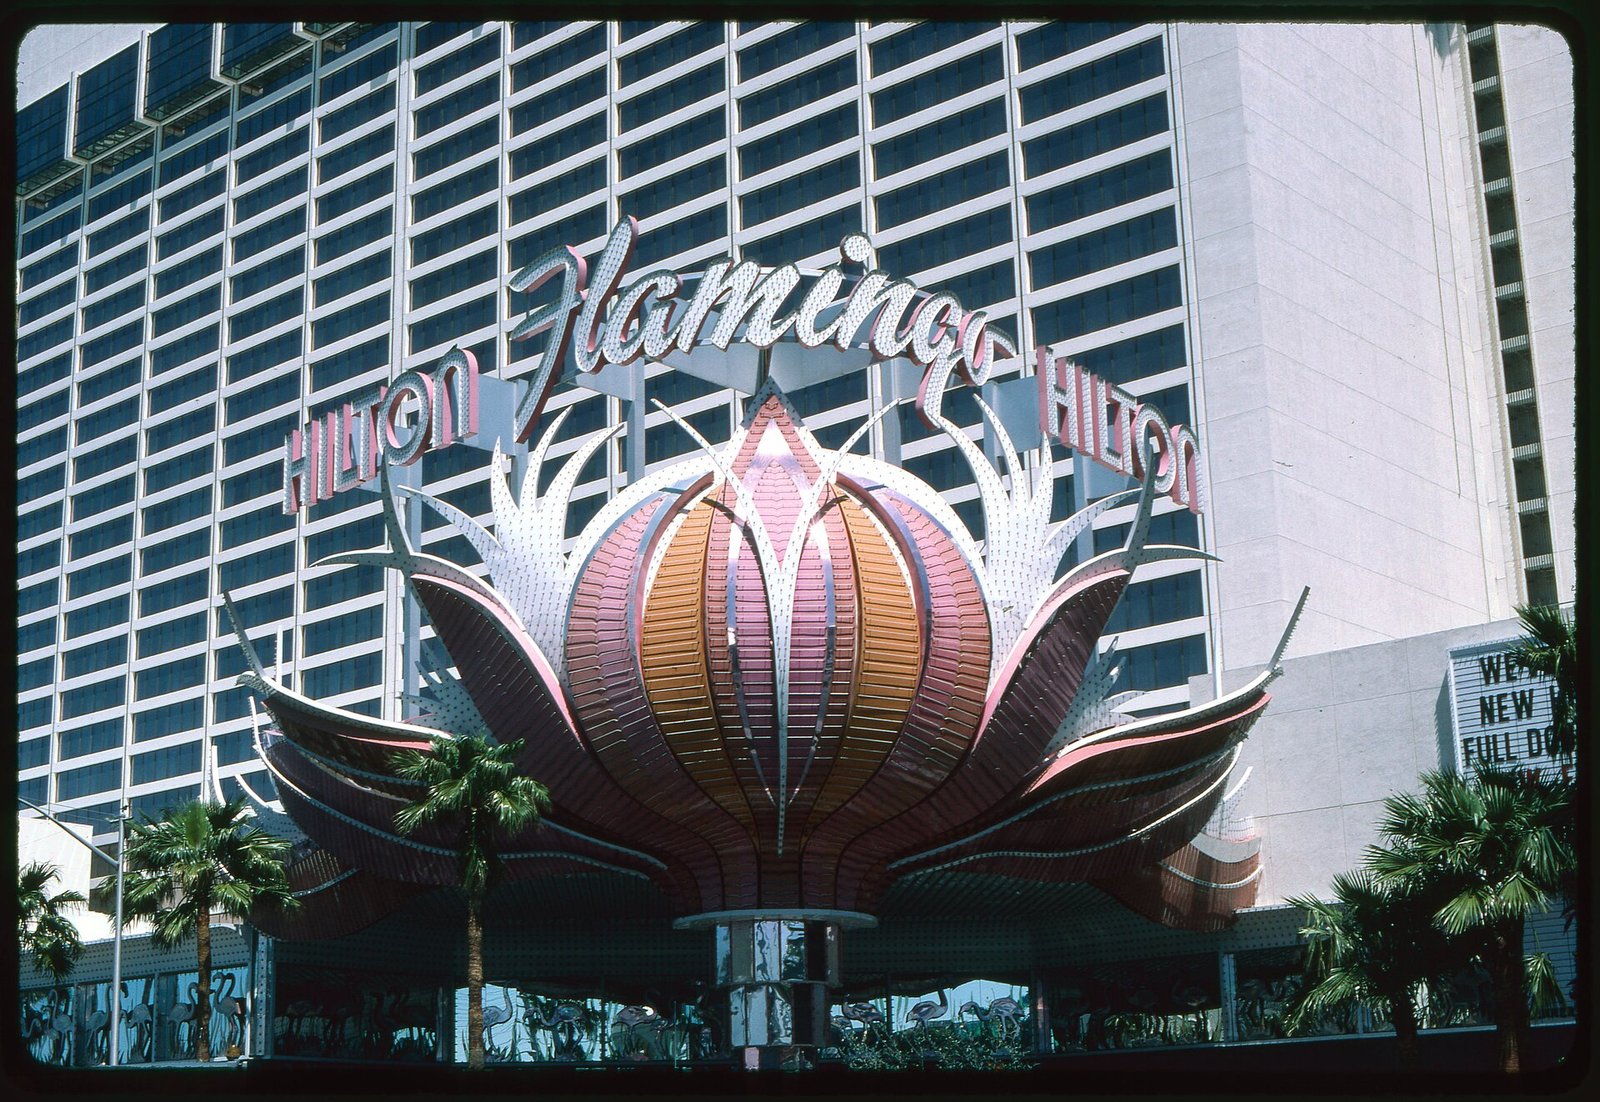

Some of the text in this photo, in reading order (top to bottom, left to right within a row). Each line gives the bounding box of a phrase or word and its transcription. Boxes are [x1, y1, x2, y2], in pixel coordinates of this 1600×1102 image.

[508, 215, 1017, 443] Flamingo
[1480, 689, 1534, 726] NEW
[1463, 732, 1518, 767] FULL
